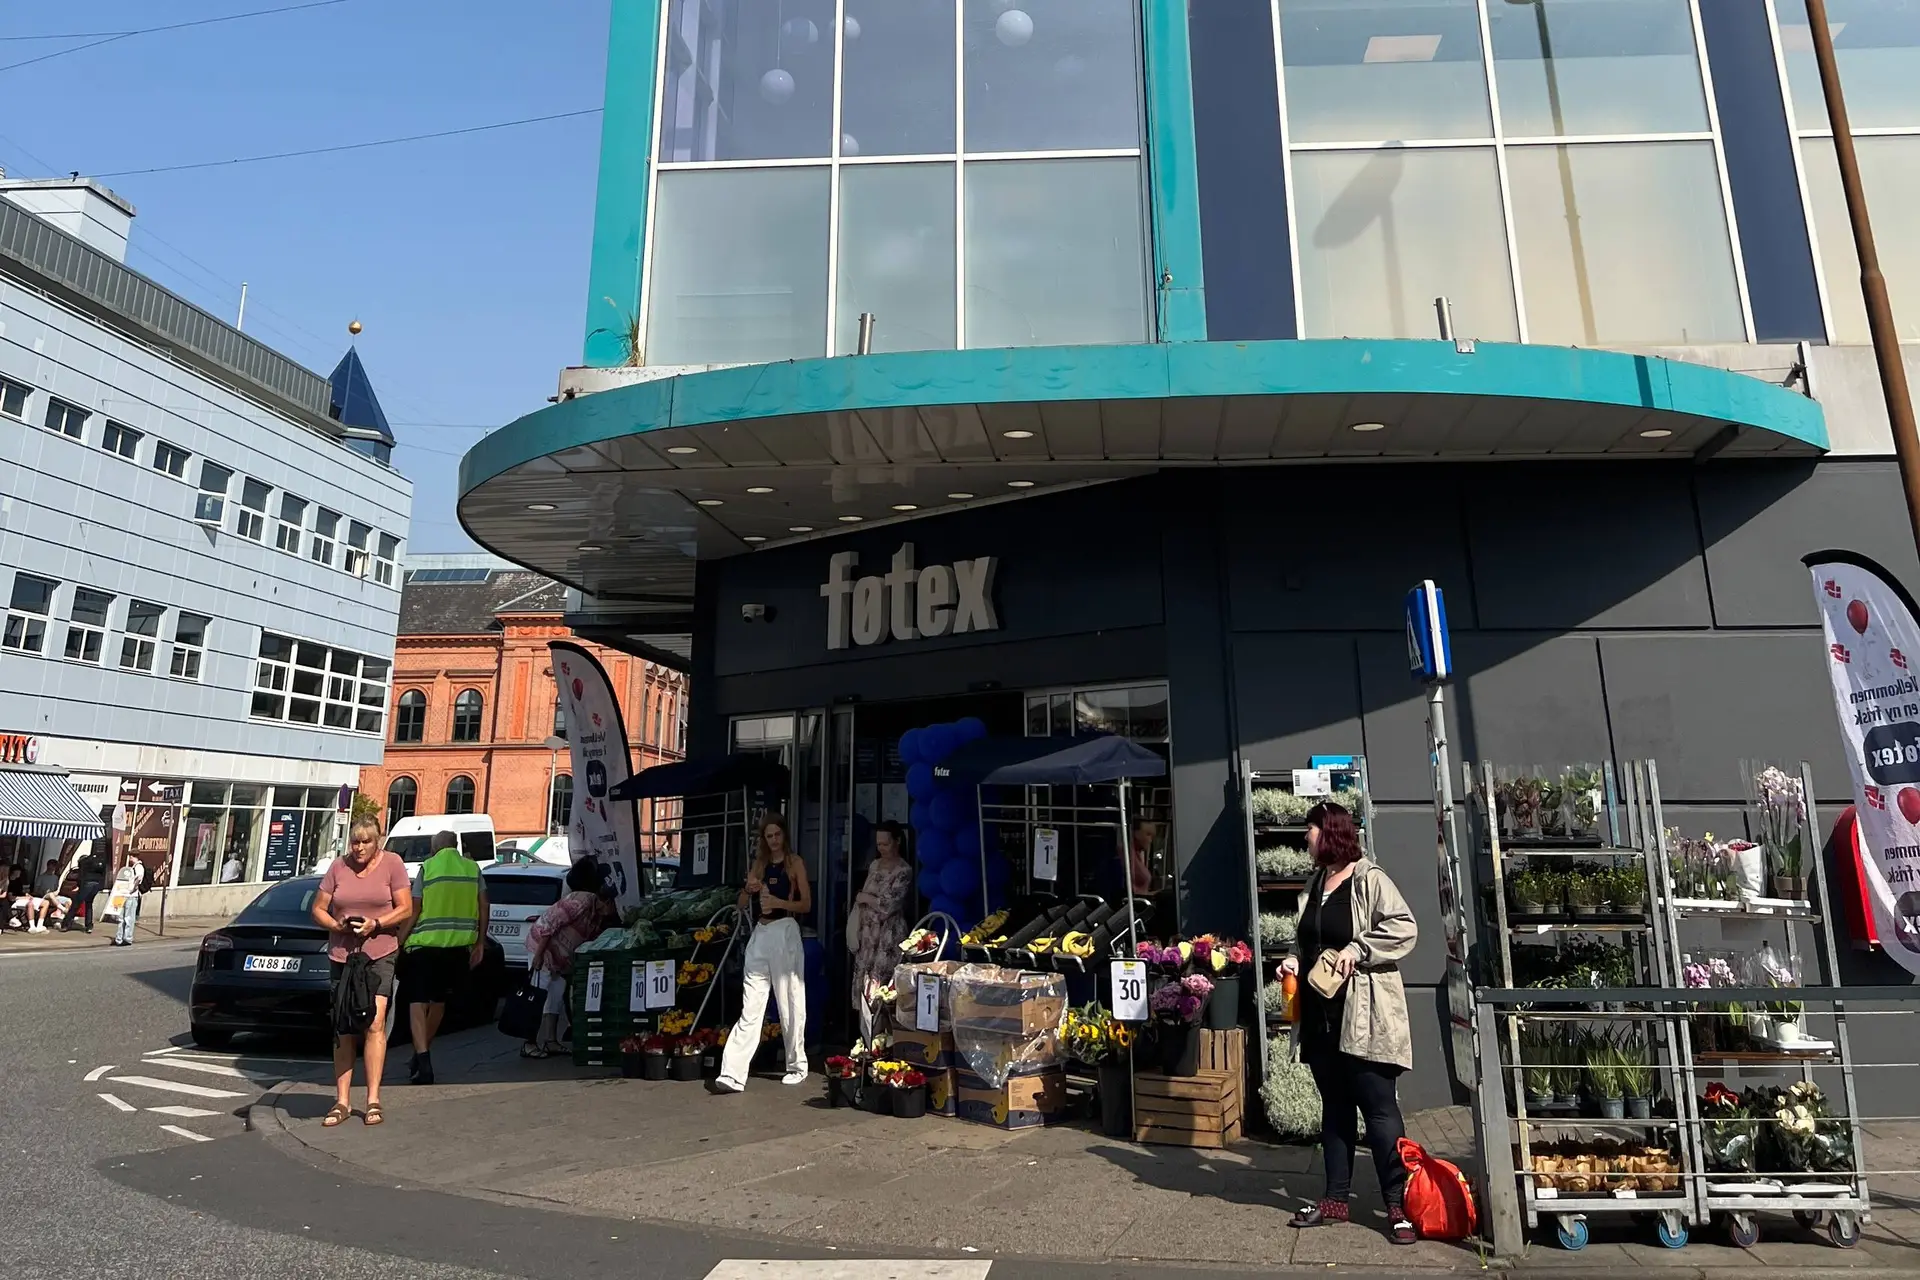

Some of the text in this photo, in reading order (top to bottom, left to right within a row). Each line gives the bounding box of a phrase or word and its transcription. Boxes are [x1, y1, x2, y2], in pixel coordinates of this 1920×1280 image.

[820, 542, 999, 650] føtex
[252, 958, 299, 970] CN 88 166
[591, 982, 600, 998] 10
[635, 981, 644, 998] 10
[652, 975, 669, 993] 10
[1118, 978, 1141, 1001] 30
